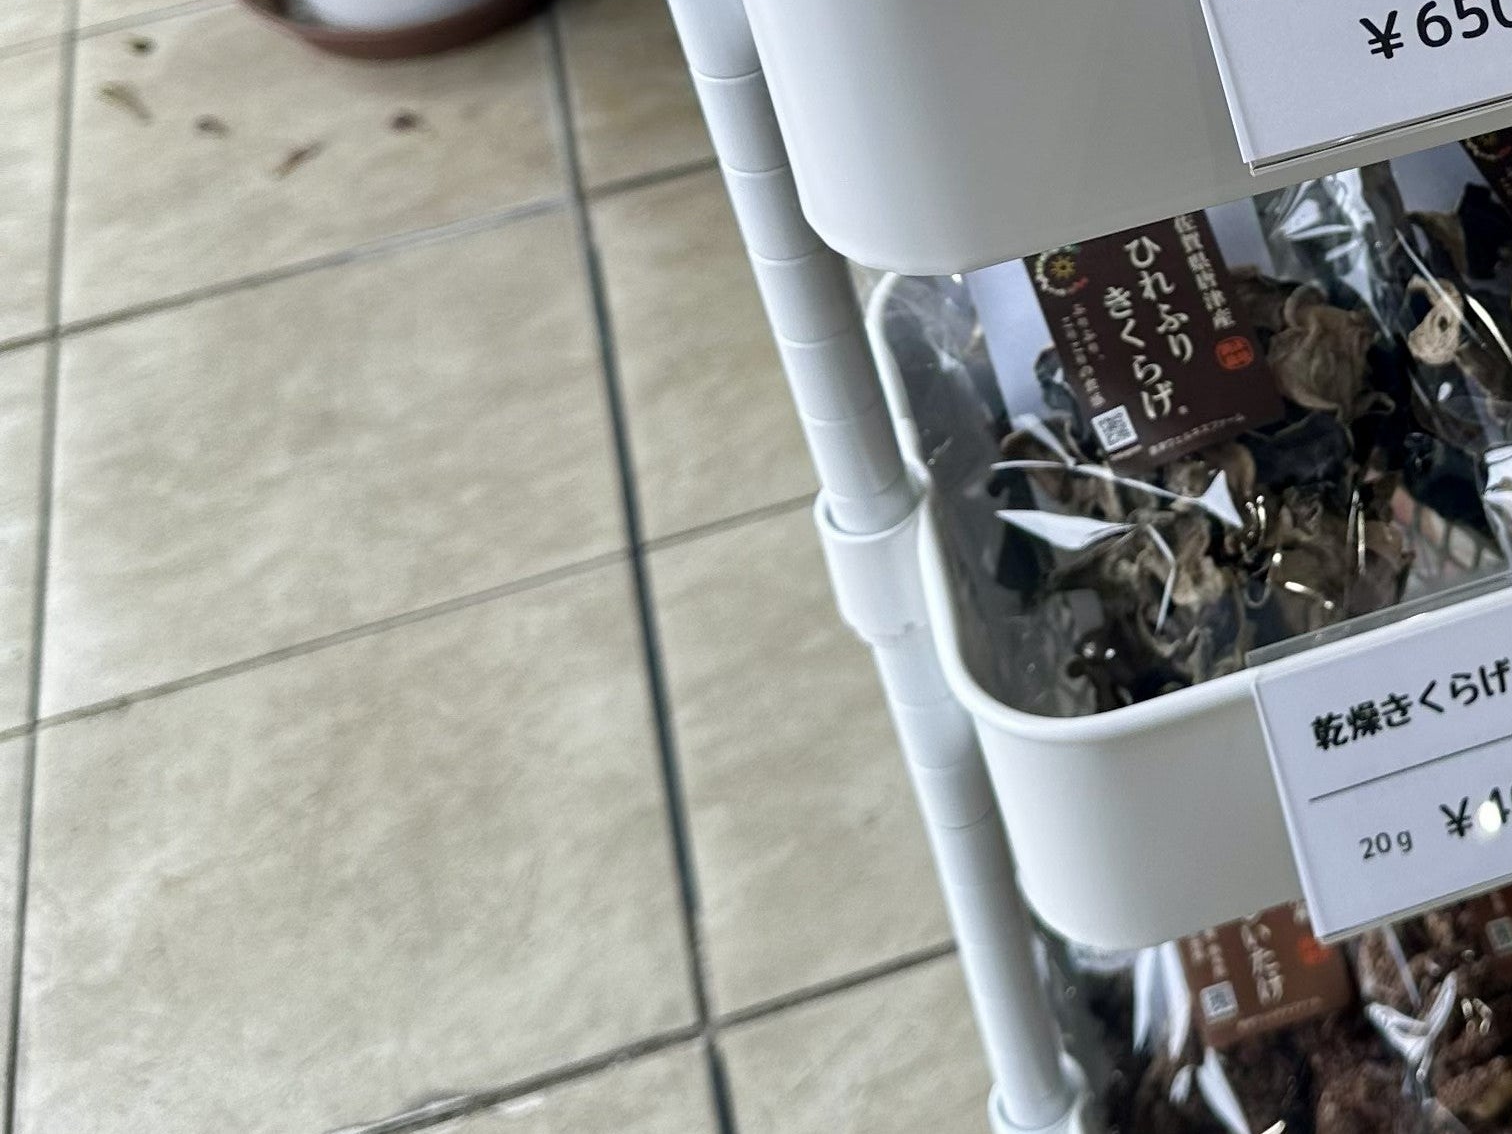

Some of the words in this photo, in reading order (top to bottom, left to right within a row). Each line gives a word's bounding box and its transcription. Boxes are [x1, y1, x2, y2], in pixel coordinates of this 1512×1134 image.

[1104, 287, 1174, 419] きくらげ
[1124, 236, 1194, 362] ひれふり
